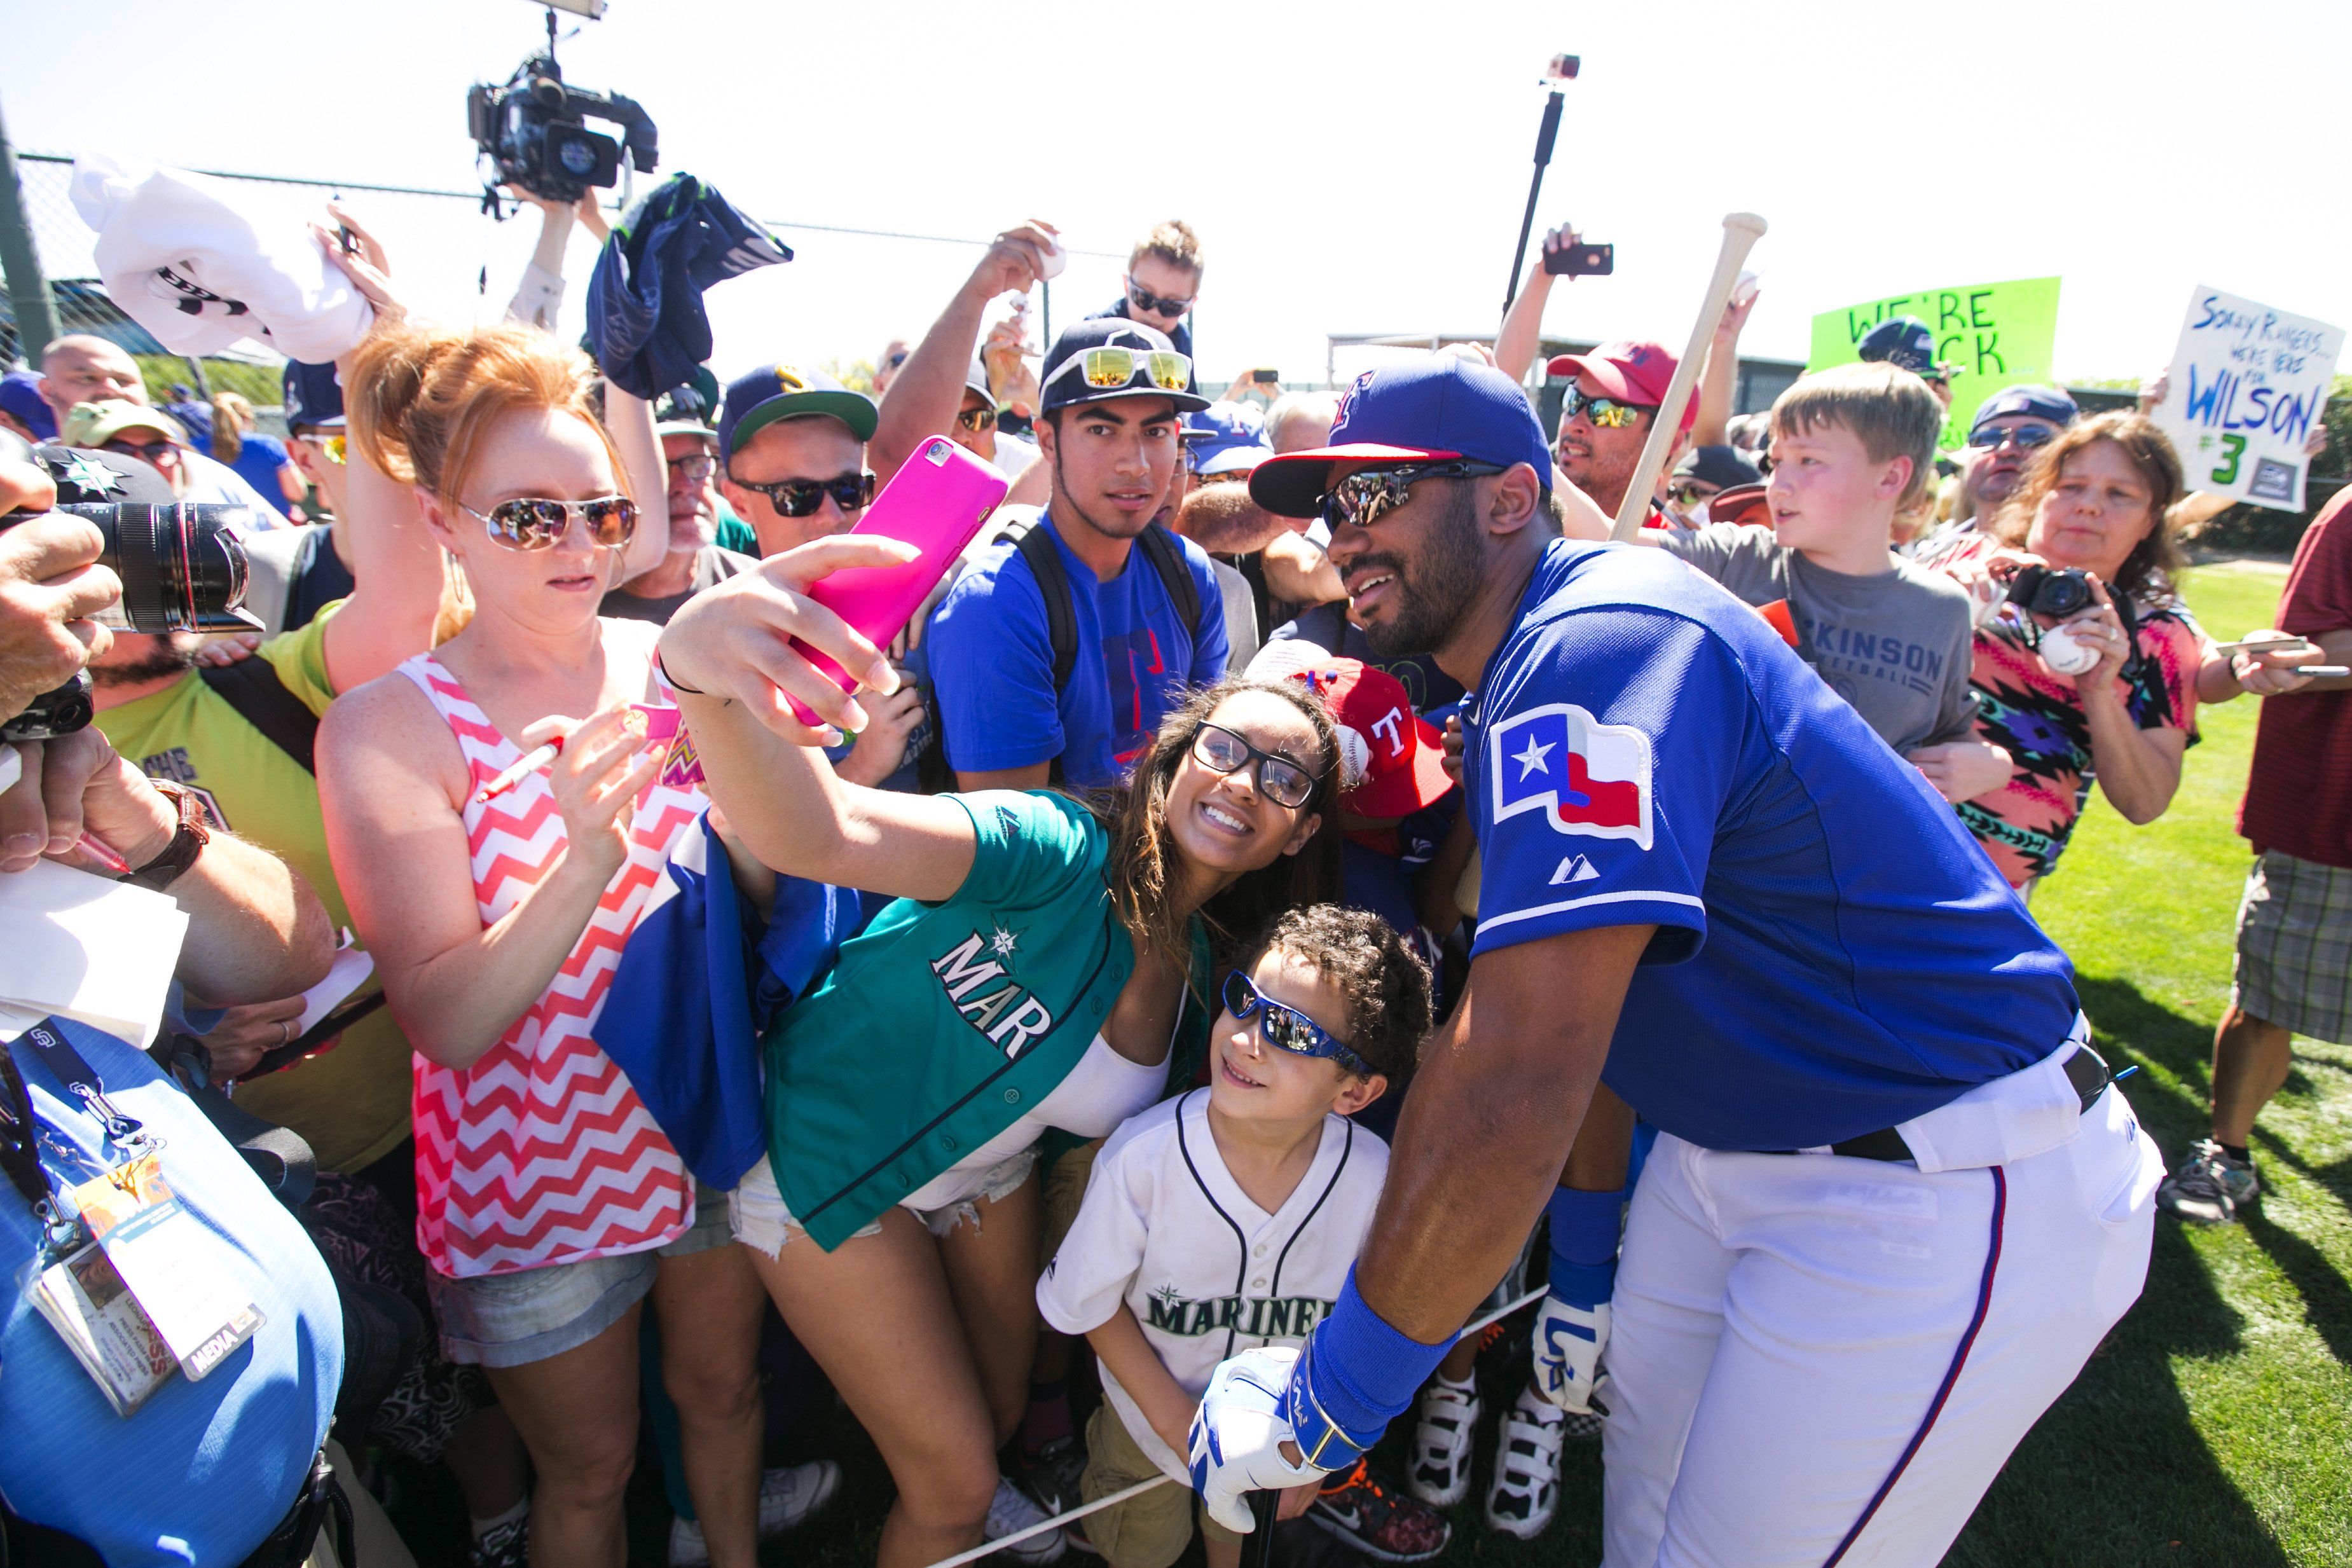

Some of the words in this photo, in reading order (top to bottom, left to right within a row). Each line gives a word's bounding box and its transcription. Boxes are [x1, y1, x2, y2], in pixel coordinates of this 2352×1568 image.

[2185, 362, 2323, 444] WILSON
[1370, 706, 1405, 758] T
[928, 927, 1054, 1061] MAR
[190, 1328, 239, 1374] MEDIA
